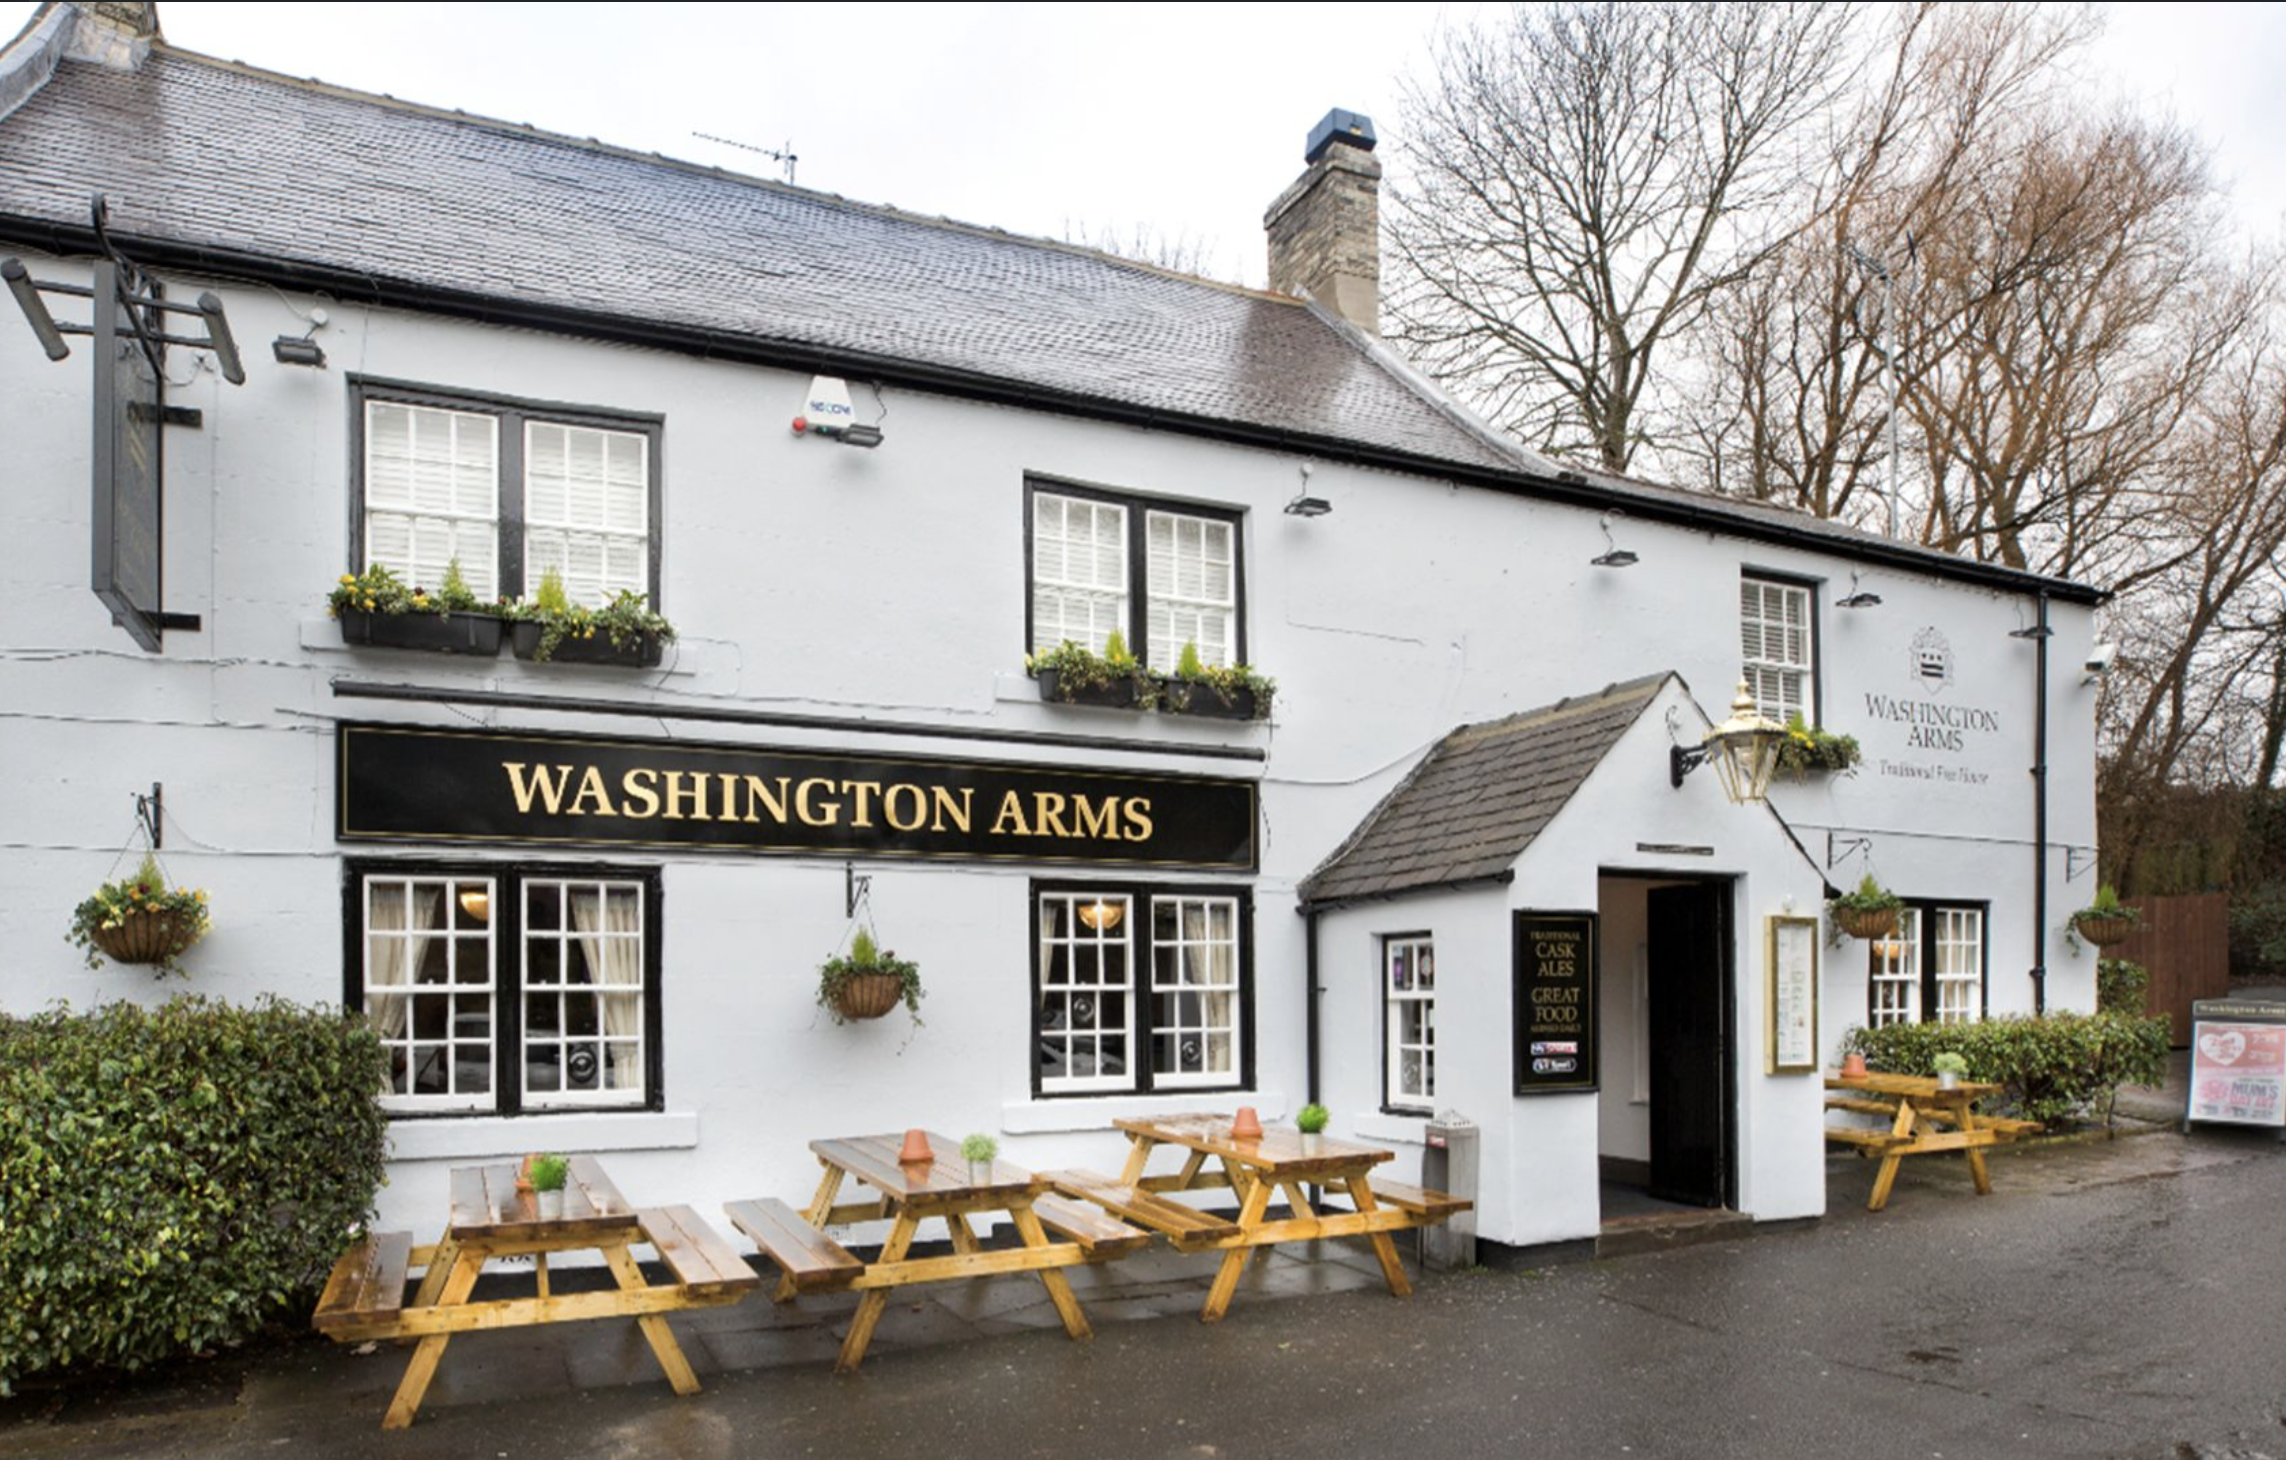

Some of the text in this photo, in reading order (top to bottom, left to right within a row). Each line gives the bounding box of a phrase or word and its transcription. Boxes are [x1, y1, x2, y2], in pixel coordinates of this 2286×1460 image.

[1865, 692, 1998, 732] WASHINGTON
[1907, 725, 1964, 752] ARMS
[502, 761, 1153, 841] WASHINGTON ARMS
[1535, 941, 1576, 958] CASK
[1537, 960, 1575, 977] ALES
[1531, 987, 1580, 1004] GREAT
[1535, 1006, 1578, 1022] FOOD
